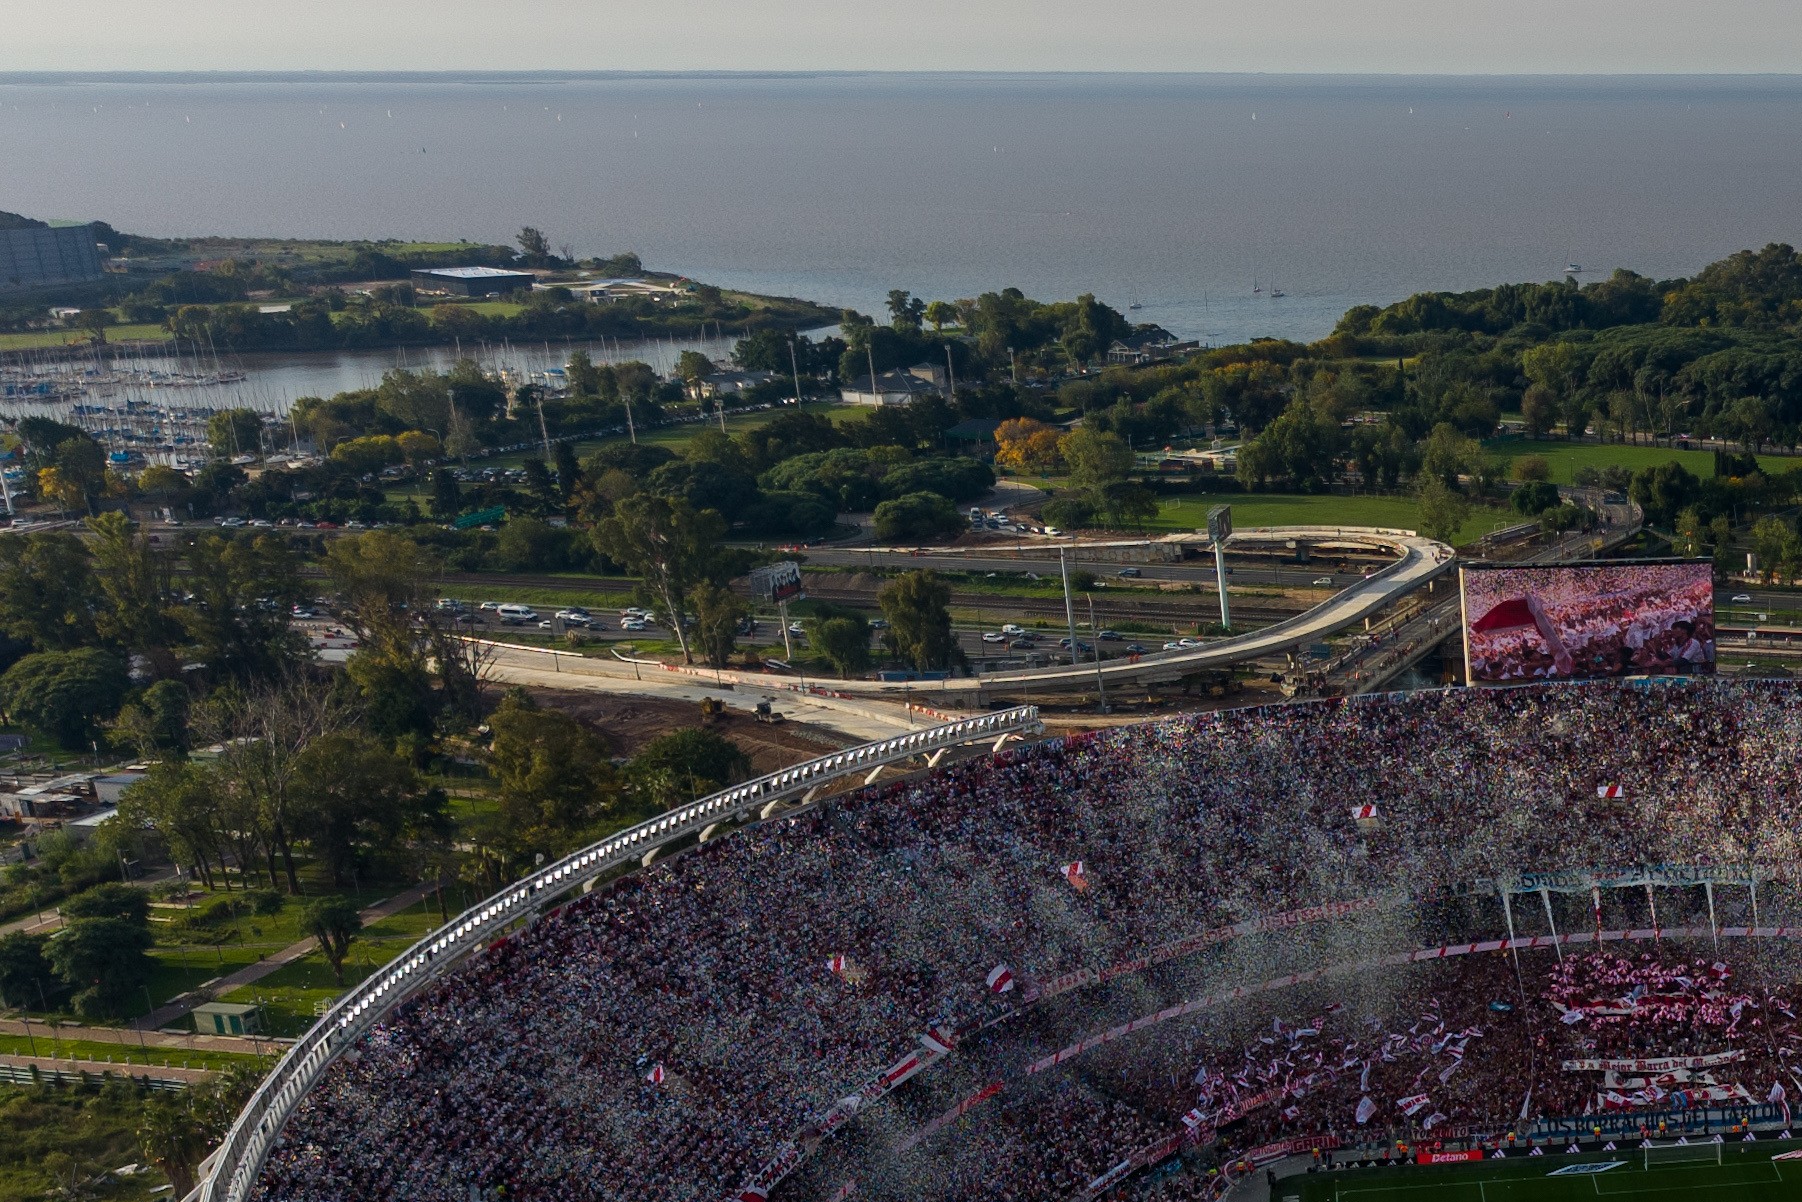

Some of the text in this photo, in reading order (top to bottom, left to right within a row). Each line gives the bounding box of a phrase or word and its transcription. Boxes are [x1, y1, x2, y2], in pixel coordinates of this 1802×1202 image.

[1537, 1117, 1572, 1136] LOS
[1293, 1136, 1339, 1151] GARIN
[1432, 1152, 1469, 1163] Betano
